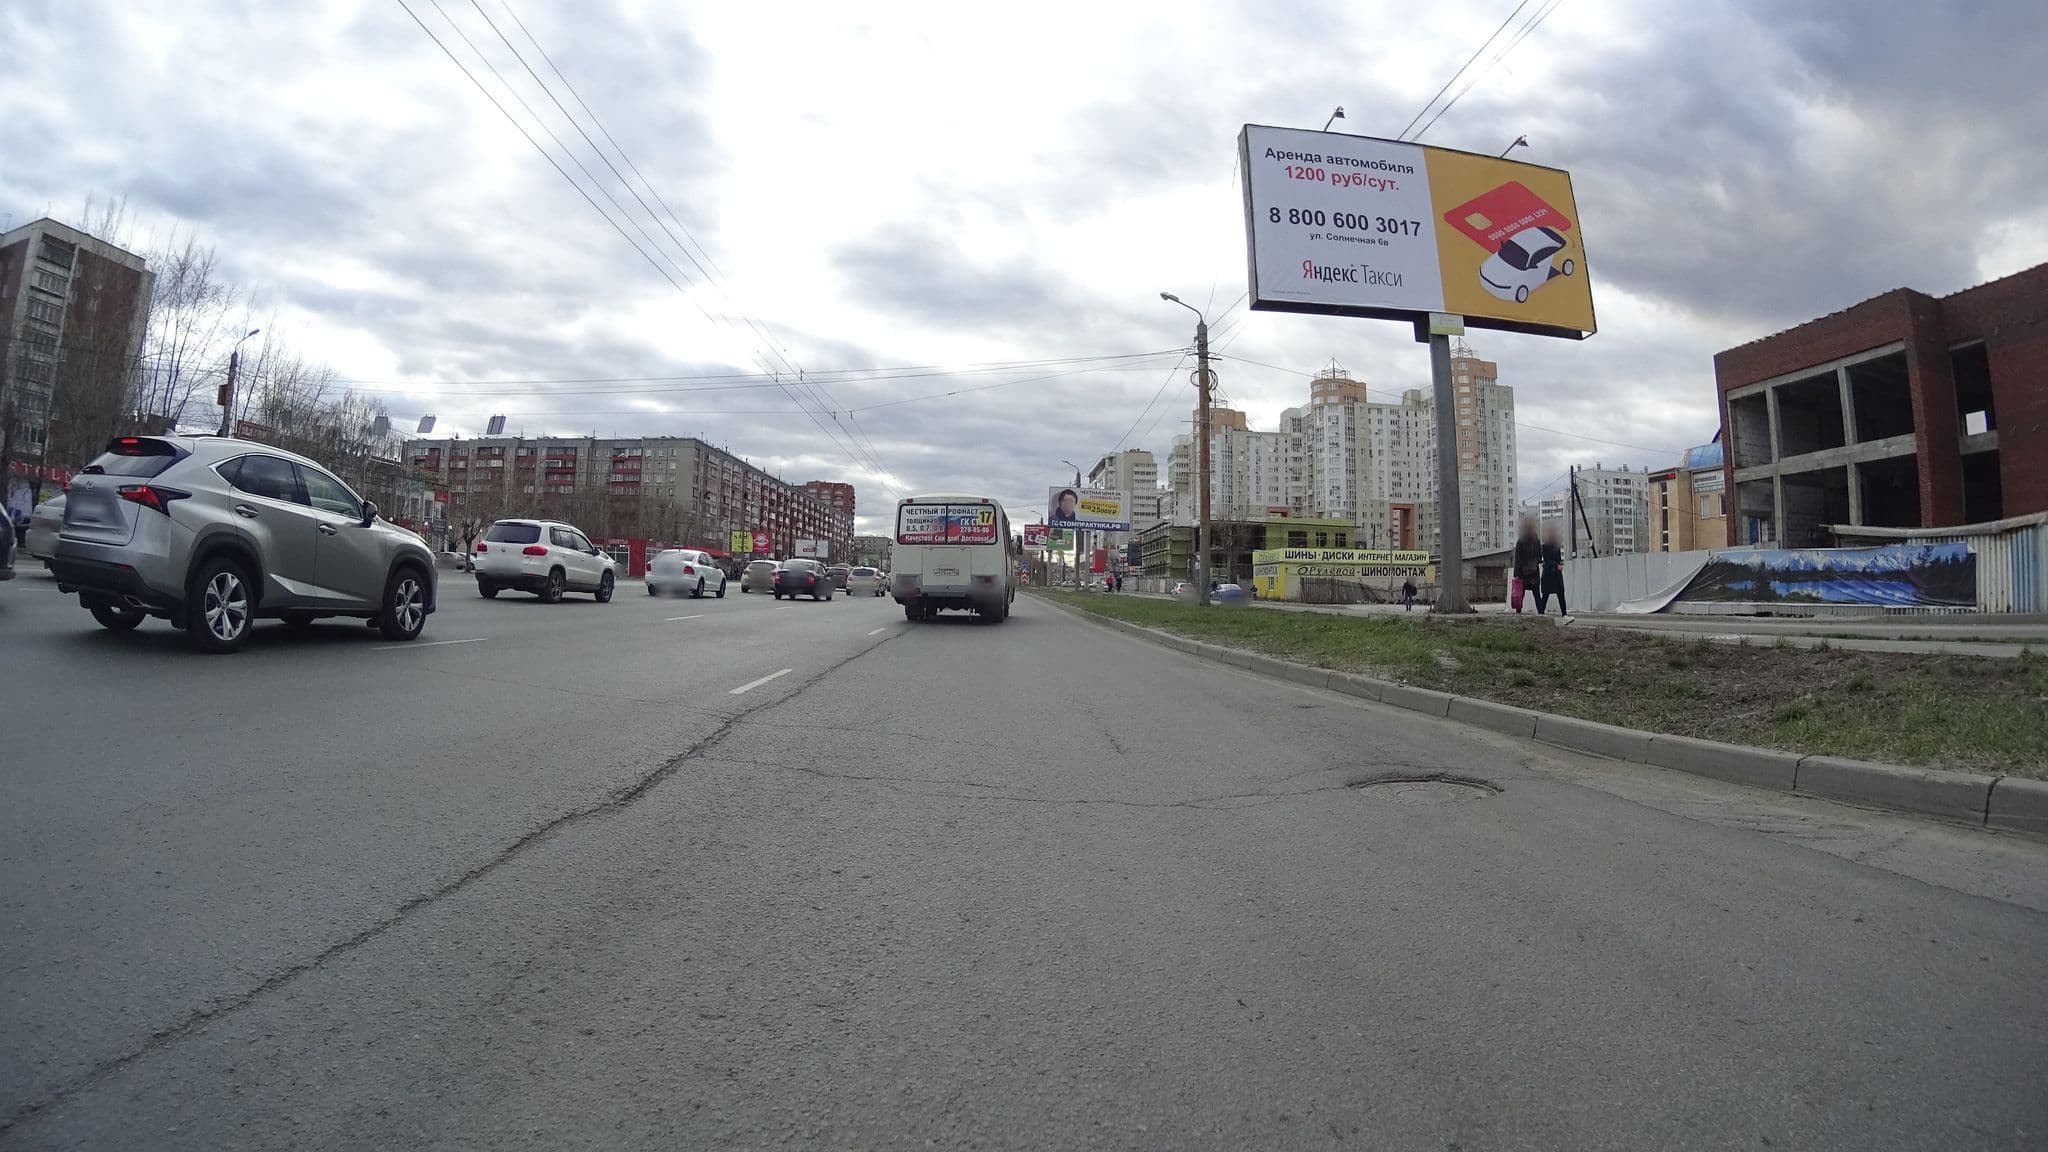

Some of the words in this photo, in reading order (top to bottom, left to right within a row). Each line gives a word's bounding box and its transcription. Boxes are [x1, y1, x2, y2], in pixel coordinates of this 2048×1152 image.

[1265, 147, 1322, 163] Аренда
[1326, 154, 1415, 175] автомобиля
[1284, 165, 1325, 182] 1200
[1331, 172, 1400, 192] руб/сут.
[1269, 207, 1281, 224] 8
[1289, 208, 1326, 227] 800
[1333, 212, 1369, 231] 600
[1376, 216, 1421, 237] 3017
[1309, 232, 1324, 241] ул.
[1326, 233, 1376, 245] Солнечная
[1302, 260, 1358, 283] Яндекс
[1360, 264, 1403, 287] Такси
[980, 511, 992, 523] 17
[1285, 550, 1317, 560] ШИНЫ
[1322, 551, 1354, 562] ДИСКИ
[1394, 554, 1427, 562] МАГАЗИН
[1361, 567, 1426, 577] ШИНОМОНТАЖ
